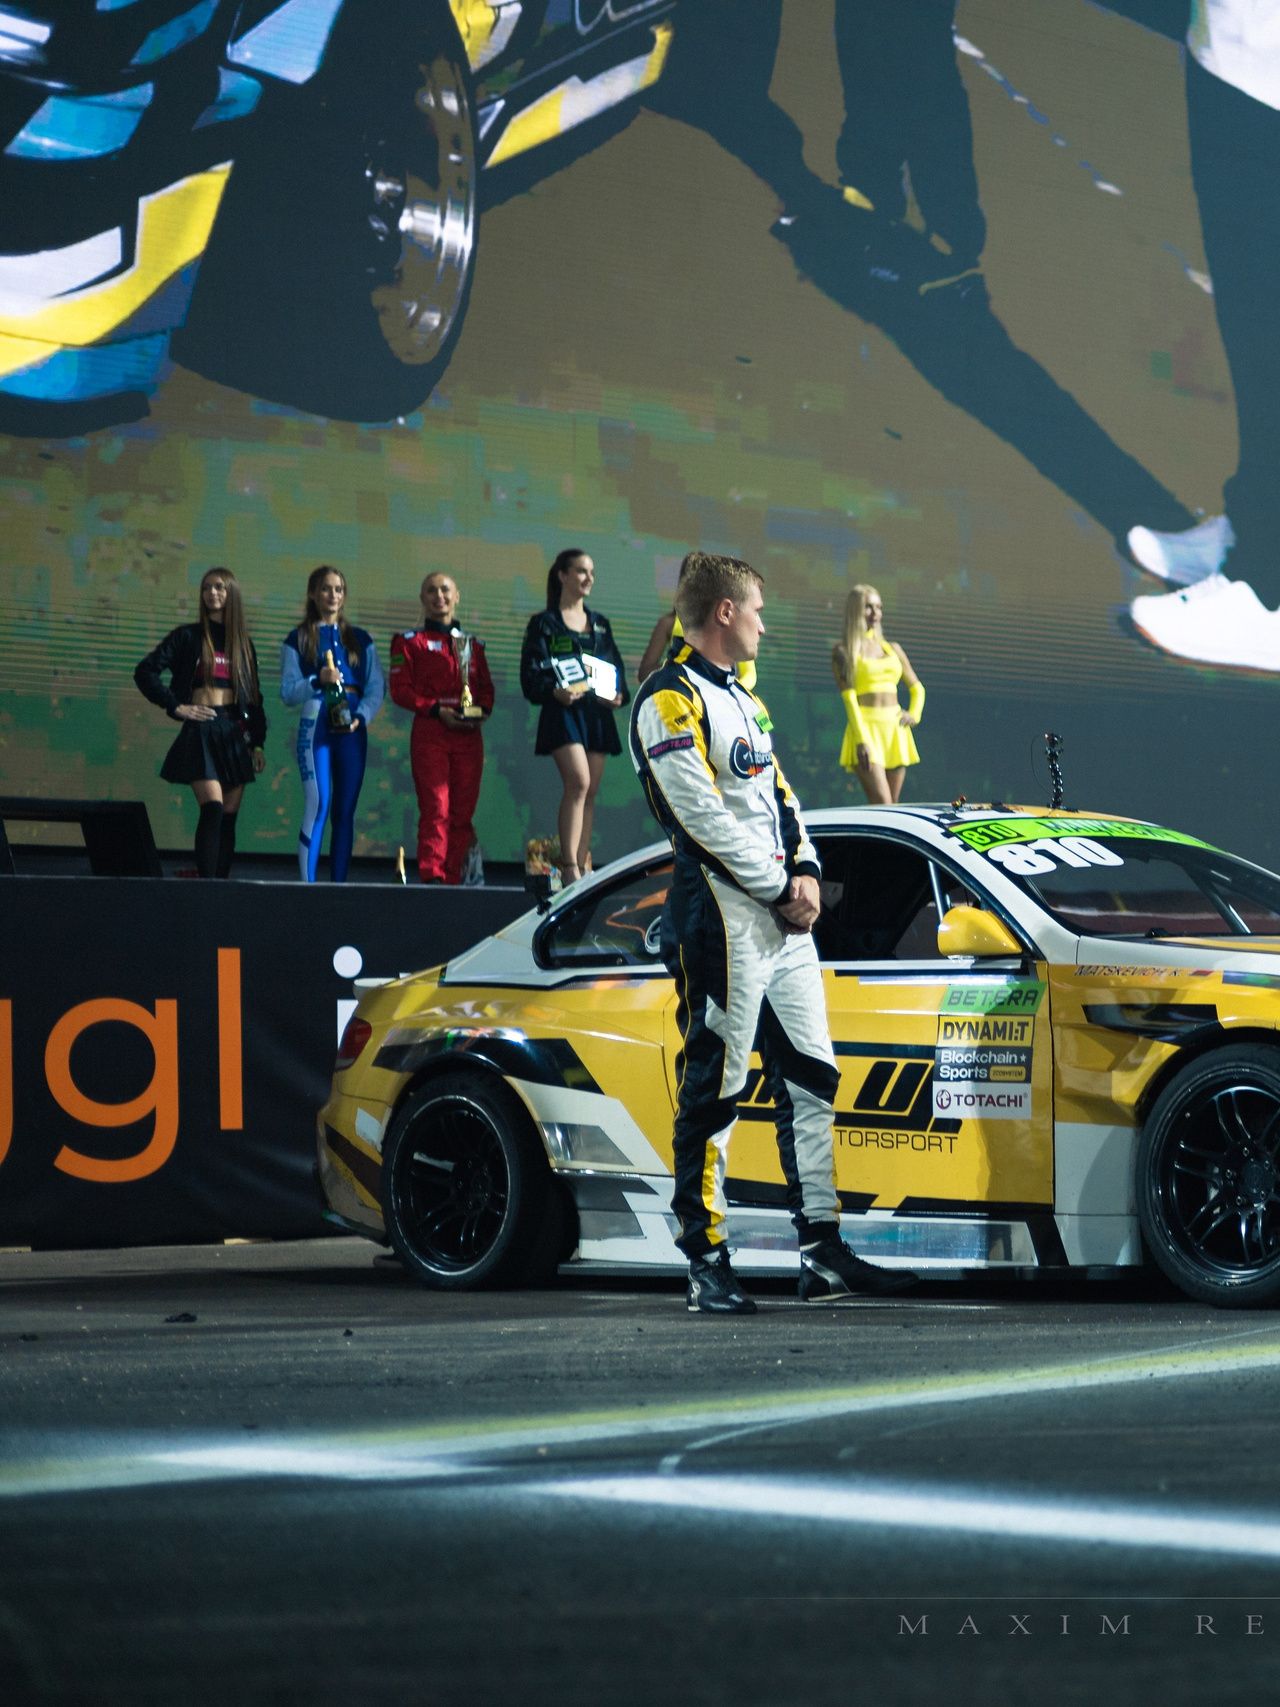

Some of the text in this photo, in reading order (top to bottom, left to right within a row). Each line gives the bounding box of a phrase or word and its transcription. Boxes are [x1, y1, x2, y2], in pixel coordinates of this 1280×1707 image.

[958, 822, 1013, 845] 810
[987, 837, 1125, 875] 810
[947, 989, 1039, 1007] BET.ERA
[940, 1049, 1018, 1064] Blockchain
[939, 1065, 988, 1081] Sports
[835, 1129, 959, 1154] TORSPORT
